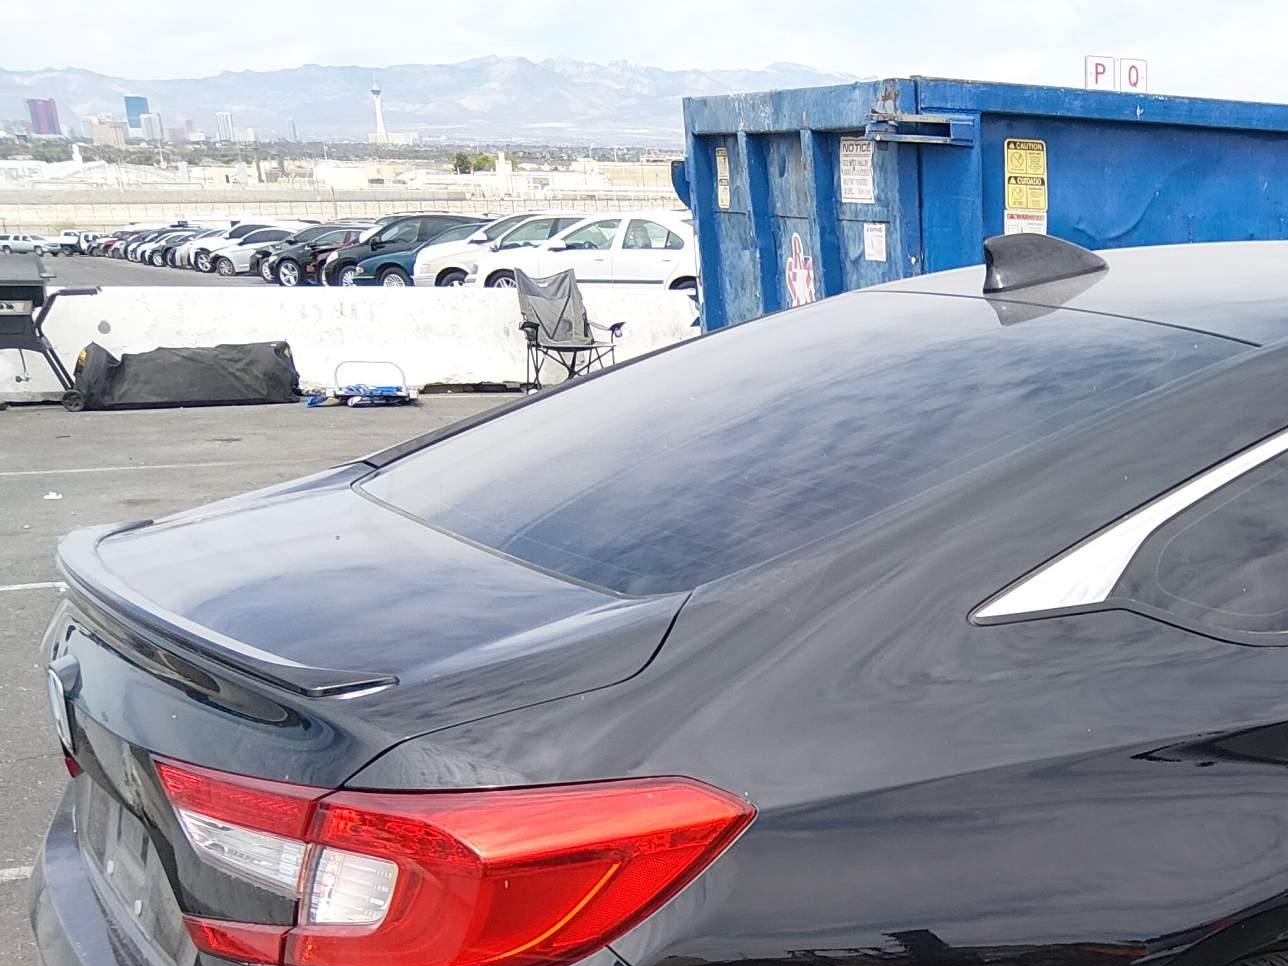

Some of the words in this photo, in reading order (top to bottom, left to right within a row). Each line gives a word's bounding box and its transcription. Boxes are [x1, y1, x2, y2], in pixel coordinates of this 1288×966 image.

[1095, 63, 1106, 84] P
[1128, 65, 1139, 88] Q
[1016, 142, 1042, 151] CAUTION
